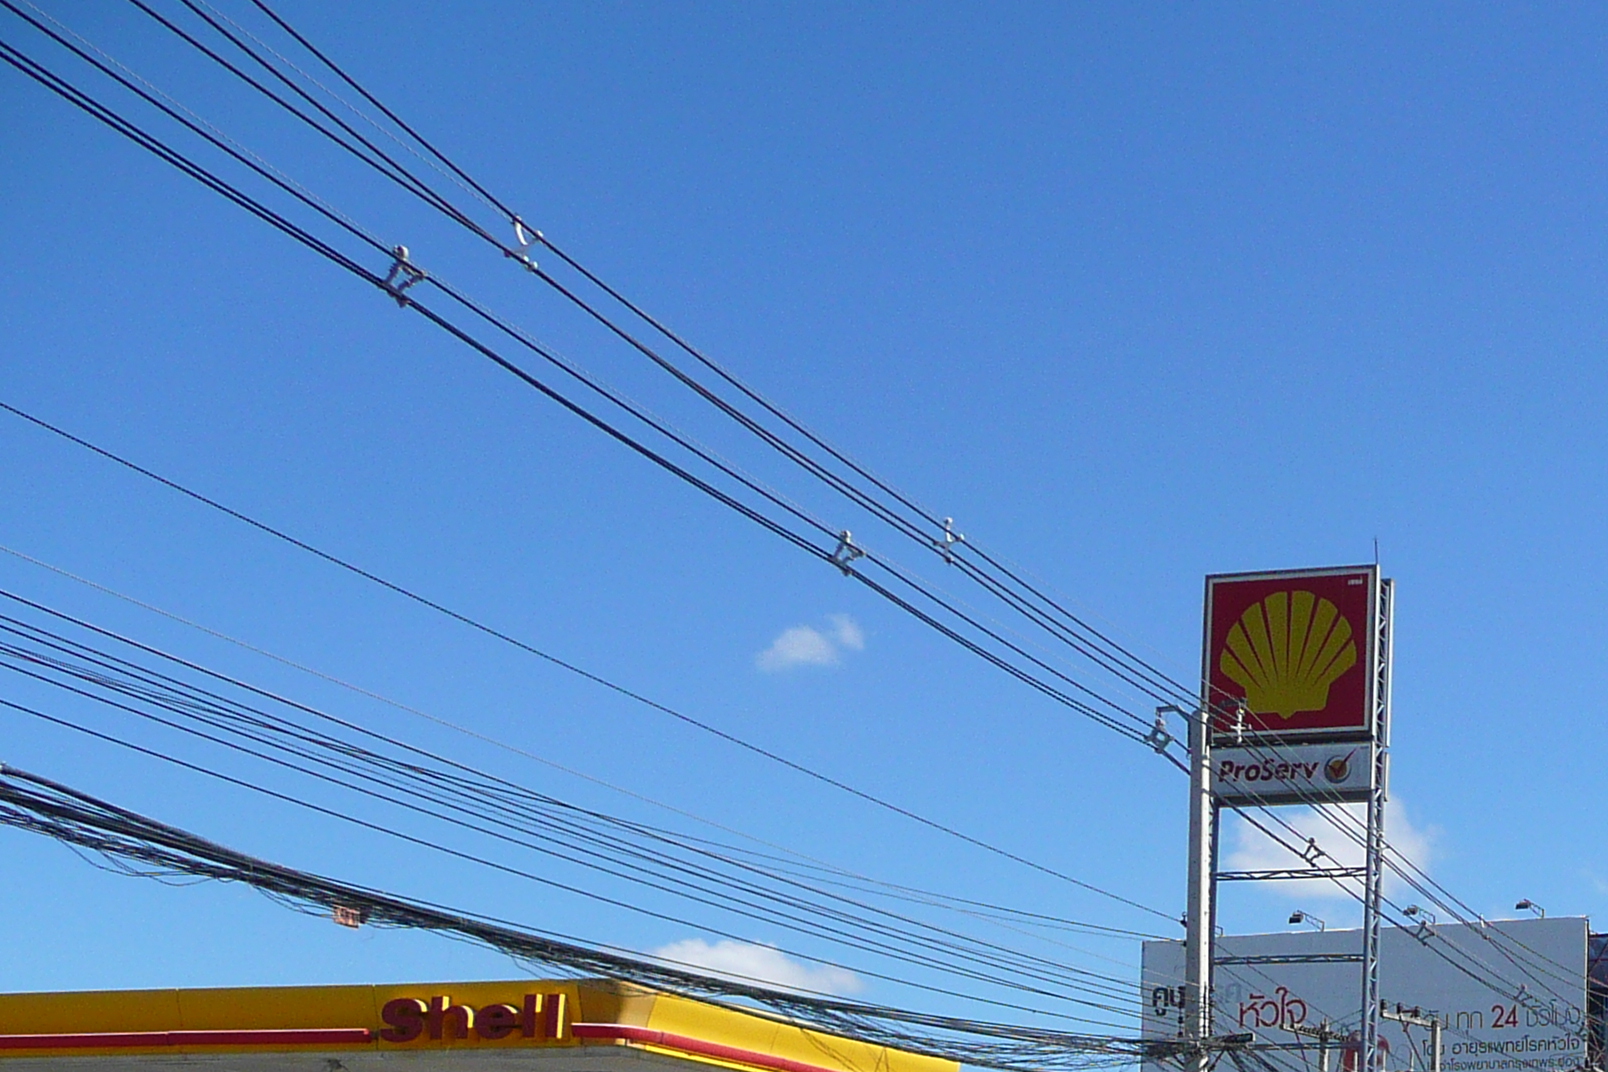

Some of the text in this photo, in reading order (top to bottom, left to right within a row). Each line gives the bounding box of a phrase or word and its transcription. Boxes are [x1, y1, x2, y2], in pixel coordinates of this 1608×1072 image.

[1217, 758, 1319, 782] ProServ
[380, 993, 565, 1043] Shell
[1238, 986, 1307, 1028] หัวใจ
[1491, 1005, 1519, 1028] 24
